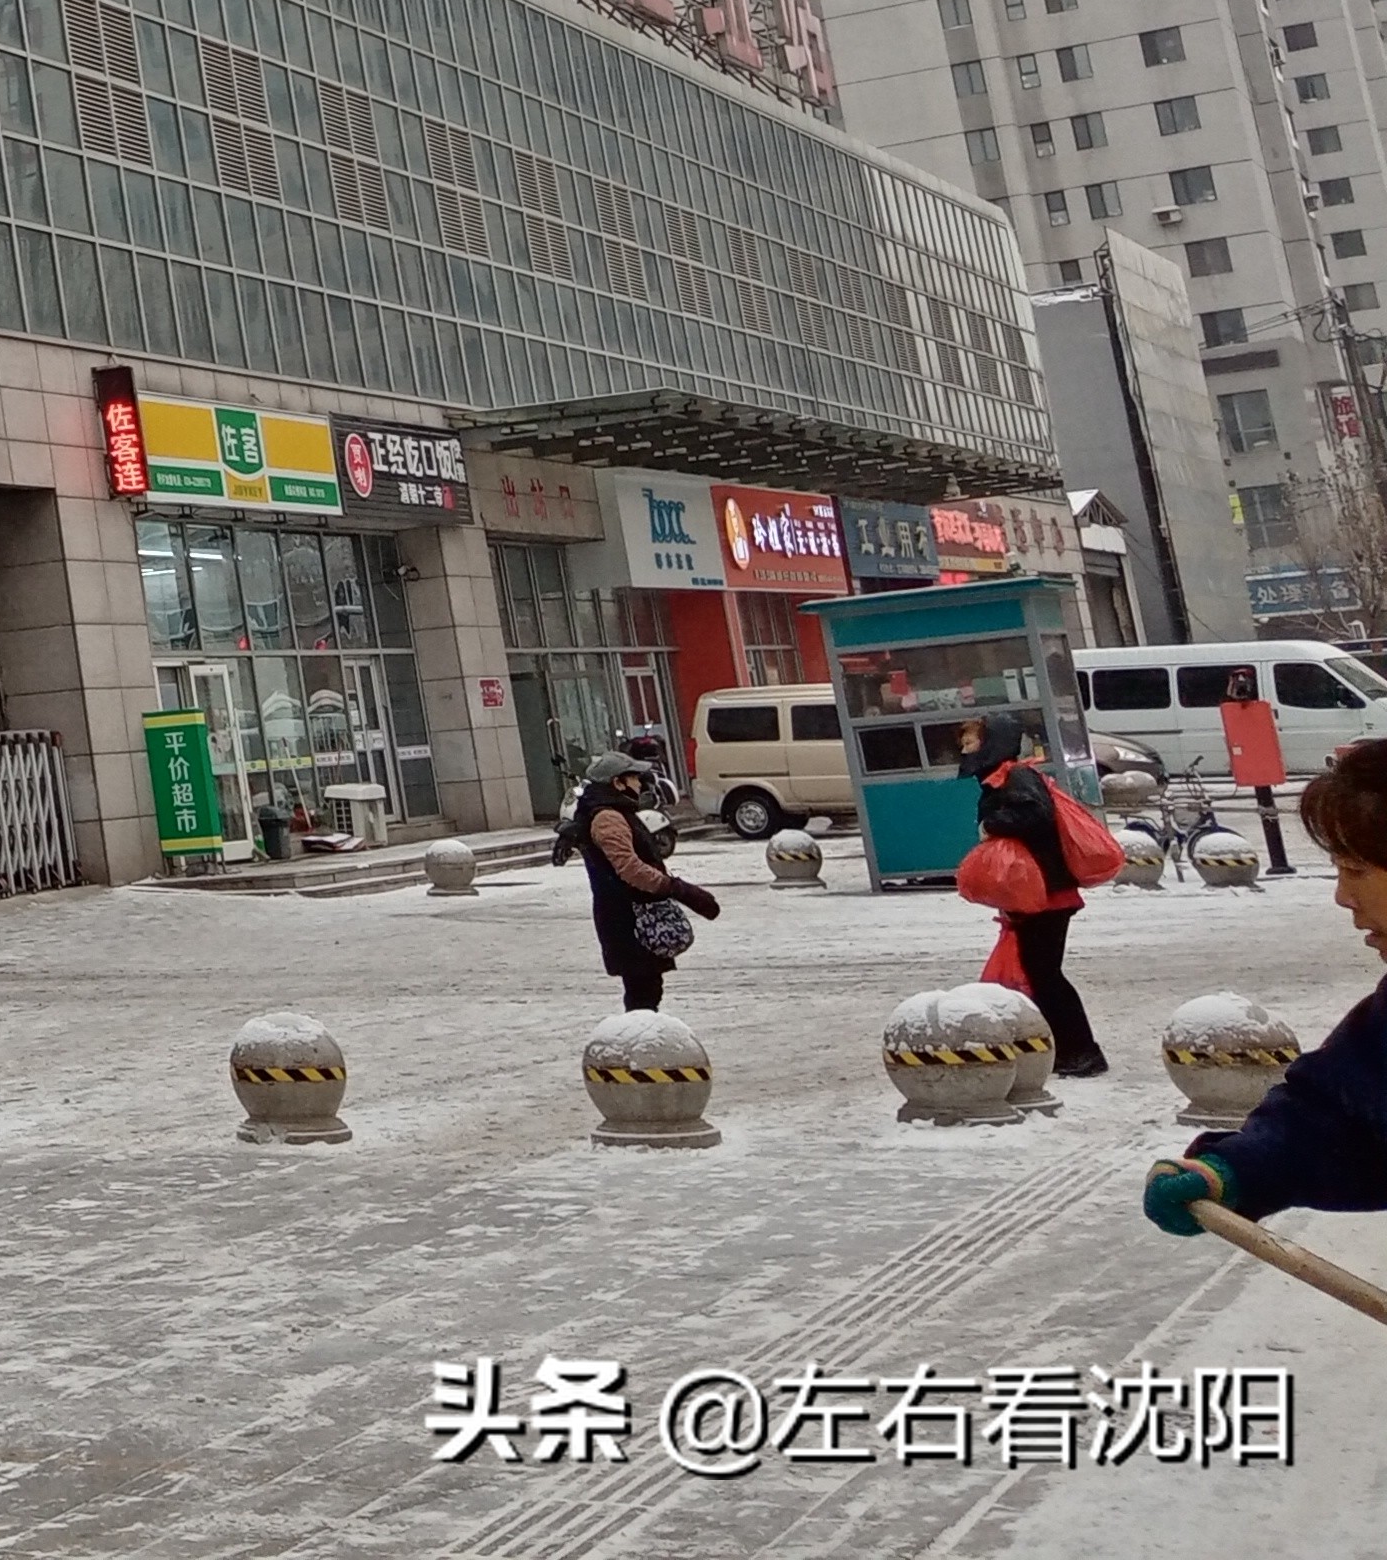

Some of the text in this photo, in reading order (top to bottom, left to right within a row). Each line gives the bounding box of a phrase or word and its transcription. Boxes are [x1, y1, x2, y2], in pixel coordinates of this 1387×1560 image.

[106, 402, 146, 492] 佐客连
[501, 474, 576, 520] 出站口
[163, 731, 198, 834] 平价超市
